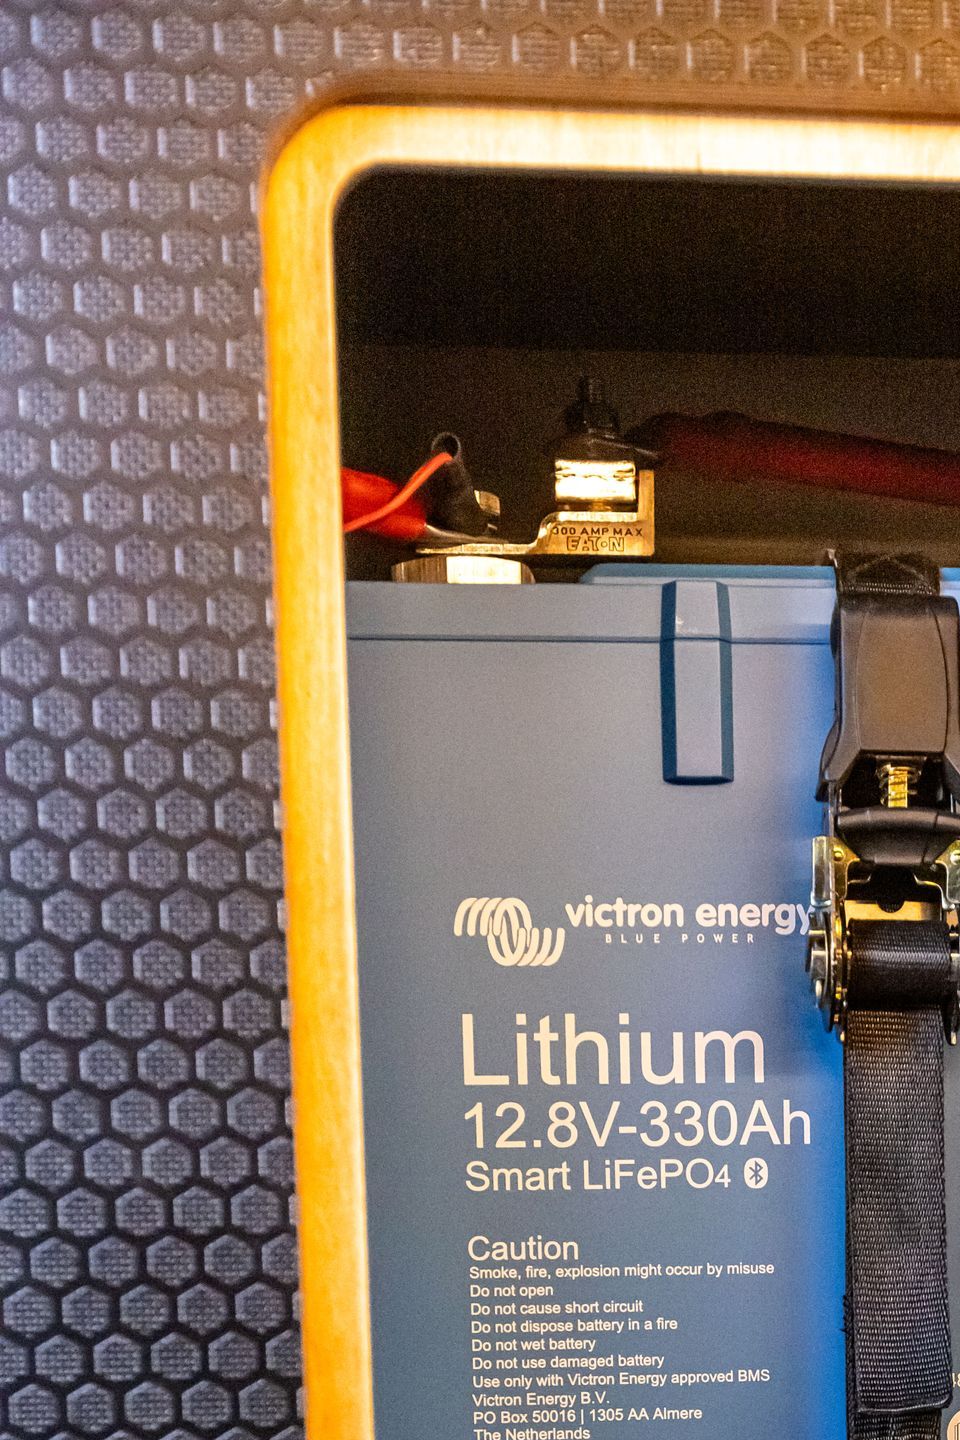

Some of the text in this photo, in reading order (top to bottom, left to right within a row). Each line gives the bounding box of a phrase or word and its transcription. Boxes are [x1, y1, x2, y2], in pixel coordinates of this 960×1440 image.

[581, 527, 609, 536] AMP
[613, 527, 642, 536] MAX
[567, 536, 624, 552] EATON
[565, 895, 815, 936] victron energy
[605, 934, 755, 943] BLUE POWER
[461, 1012, 765, 1086] Lithium
[464, 1099, 811, 1149] 12.8V-330Ah
[465, 1158, 731, 1192] Smart LiFePO4
[467, 1235, 579, 1261] Caution
[470, 1263, 774, 1280] Smoke, fire, explosion might occur by misuse
[470, 1285, 553, 1299] Do not open
[470, 1301, 643, 1316] Do not cause short circuit
[471, 1317, 677, 1334] Do not dispose battery in a fire
[471, 1338, 596, 1352] Do not wet battery
[472, 1355, 664, 1370] Do not use damaged battery
[473, 1370, 770, 1389] Use only with Victron Energy approved BMS
[473, 1392, 609, 1407] Victron Energy B.V.
[473, 1412, 497, 1425] PO
[501, 1411, 528, 1424] Box
[532, 1410, 576, 1423] 50016
[589, 1409, 623, 1422] 1305
[628, 1409, 649, 1421] AA
[653, 1407, 702, 1420] Almere
